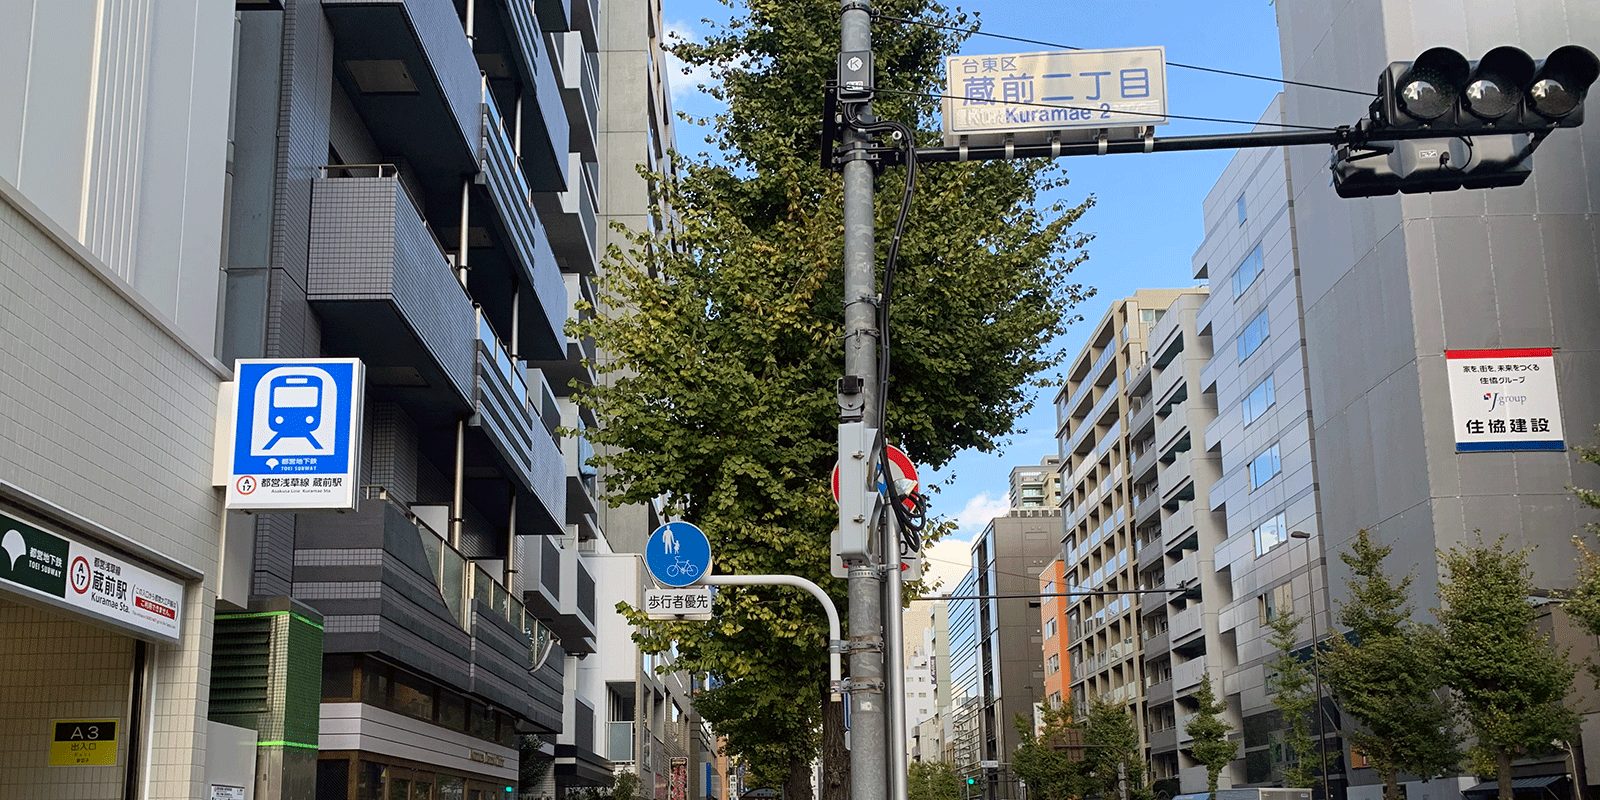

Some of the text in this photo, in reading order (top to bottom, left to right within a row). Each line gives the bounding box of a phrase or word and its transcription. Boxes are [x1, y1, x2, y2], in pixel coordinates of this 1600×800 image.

[962, 56, 1017, 74] 台東区
[962, 68, 1149, 106] 蔵前二丁目
[1005, 106, 1091, 124] Kuramae
[1099, 102, 1110, 119] 2
[1479, 376, 1526, 385] 住協グループ
[1466, 418, 1550, 434] 住協建設
[261, 478, 342, 488] 都営浅草線 蔵前駅
[30, 547, 62, 568] 都営地下鉄
[28, 560, 62, 578] TOEI SUBWAY
[78, 562, 84, 574] A
[94, 557, 121, 576] 都営浅草線
[76, 573, 86, 586] 17
[92, 570, 128, 601] 蔵前駅
[91, 592, 130, 614] Kuramae Sta.
[648, 594, 709, 609] 歩行者優先
[71, 726, 98, 740] A3
[70, 743, 96, 752] 出入口
